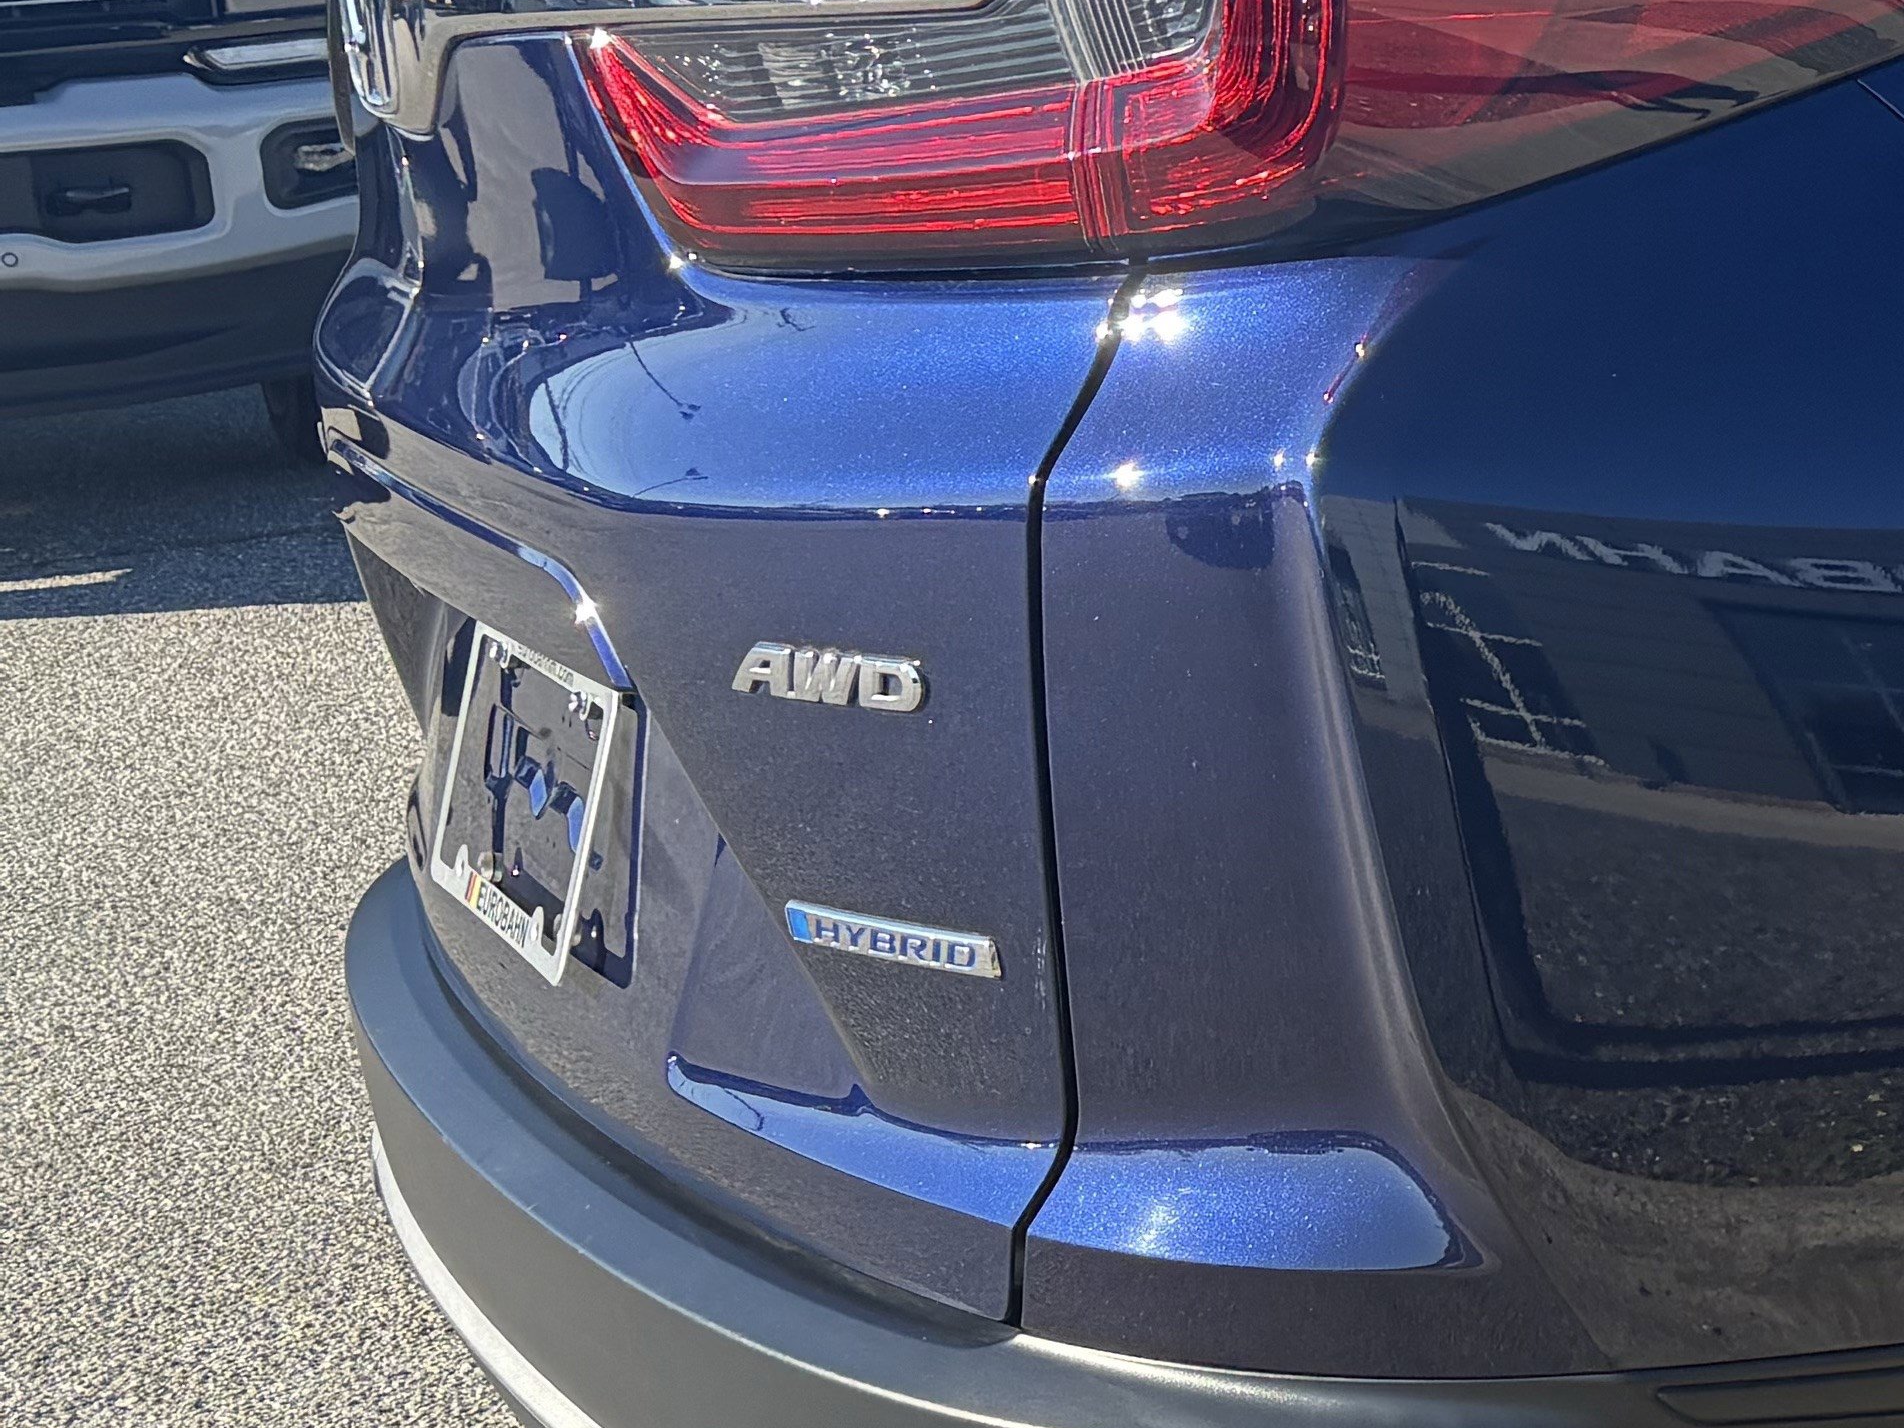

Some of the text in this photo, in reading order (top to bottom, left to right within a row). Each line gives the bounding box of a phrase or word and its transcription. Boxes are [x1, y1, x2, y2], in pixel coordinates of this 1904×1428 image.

[732, 641, 923, 712] AWD
[476, 879, 530, 949] EUROBAHN
[814, 918, 977, 970] HYBRID
